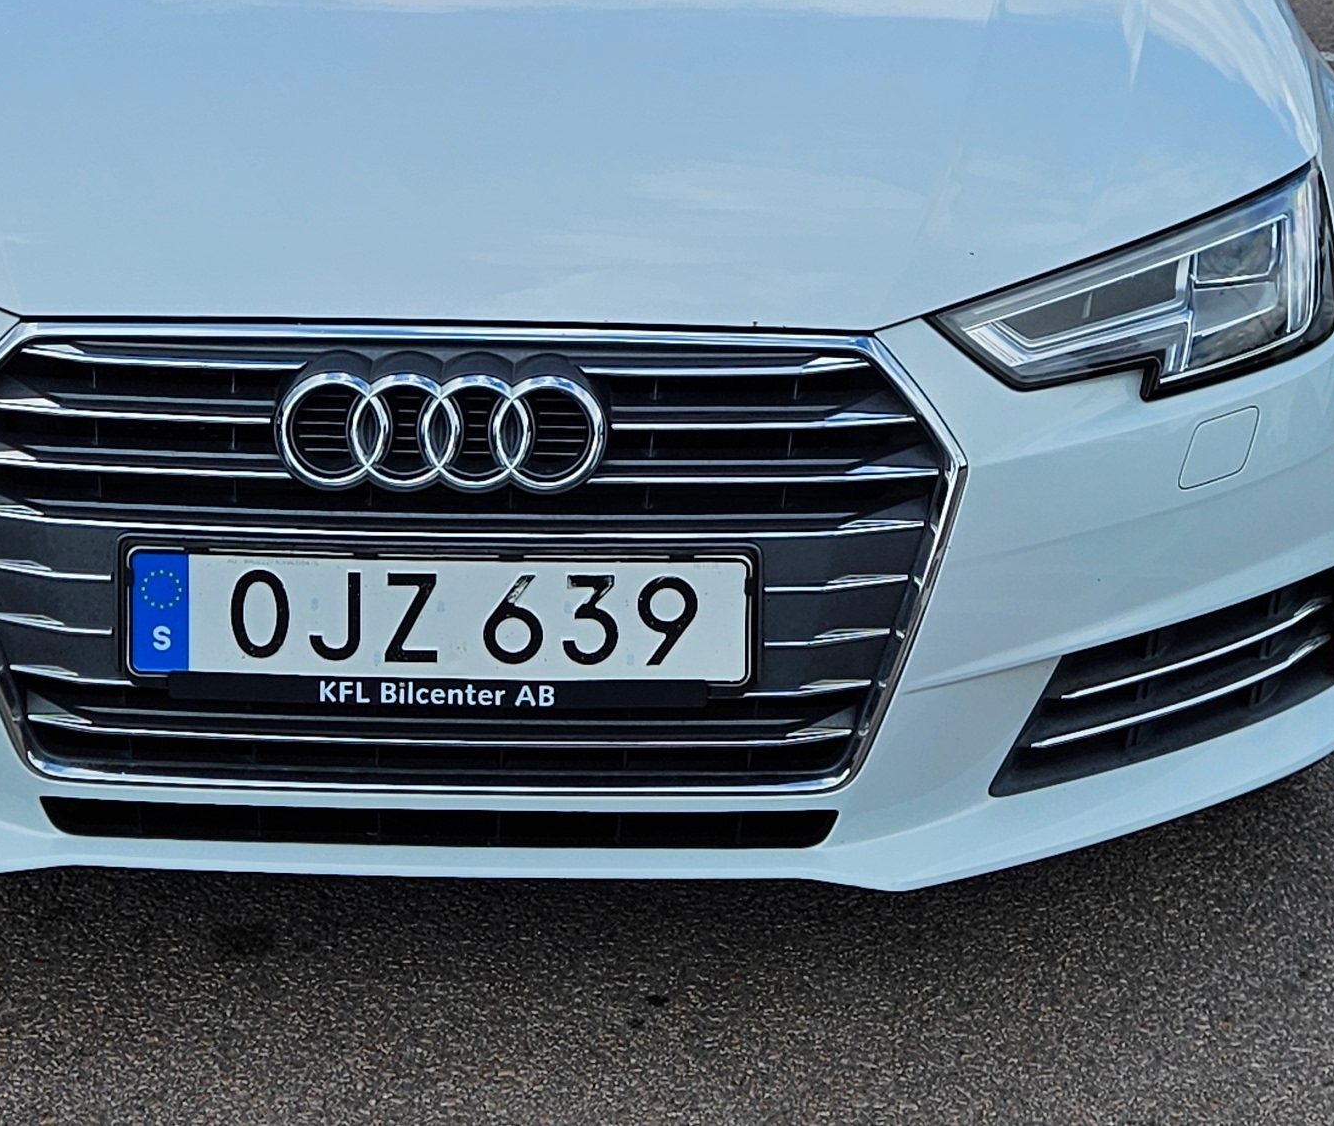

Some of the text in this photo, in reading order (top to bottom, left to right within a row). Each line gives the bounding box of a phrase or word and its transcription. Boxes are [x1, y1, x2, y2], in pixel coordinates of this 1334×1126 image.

[483, 574, 698, 666] 639
[152, 626, 171, 651] S
[320, 681, 555, 708] KFL Bilcenter AB
